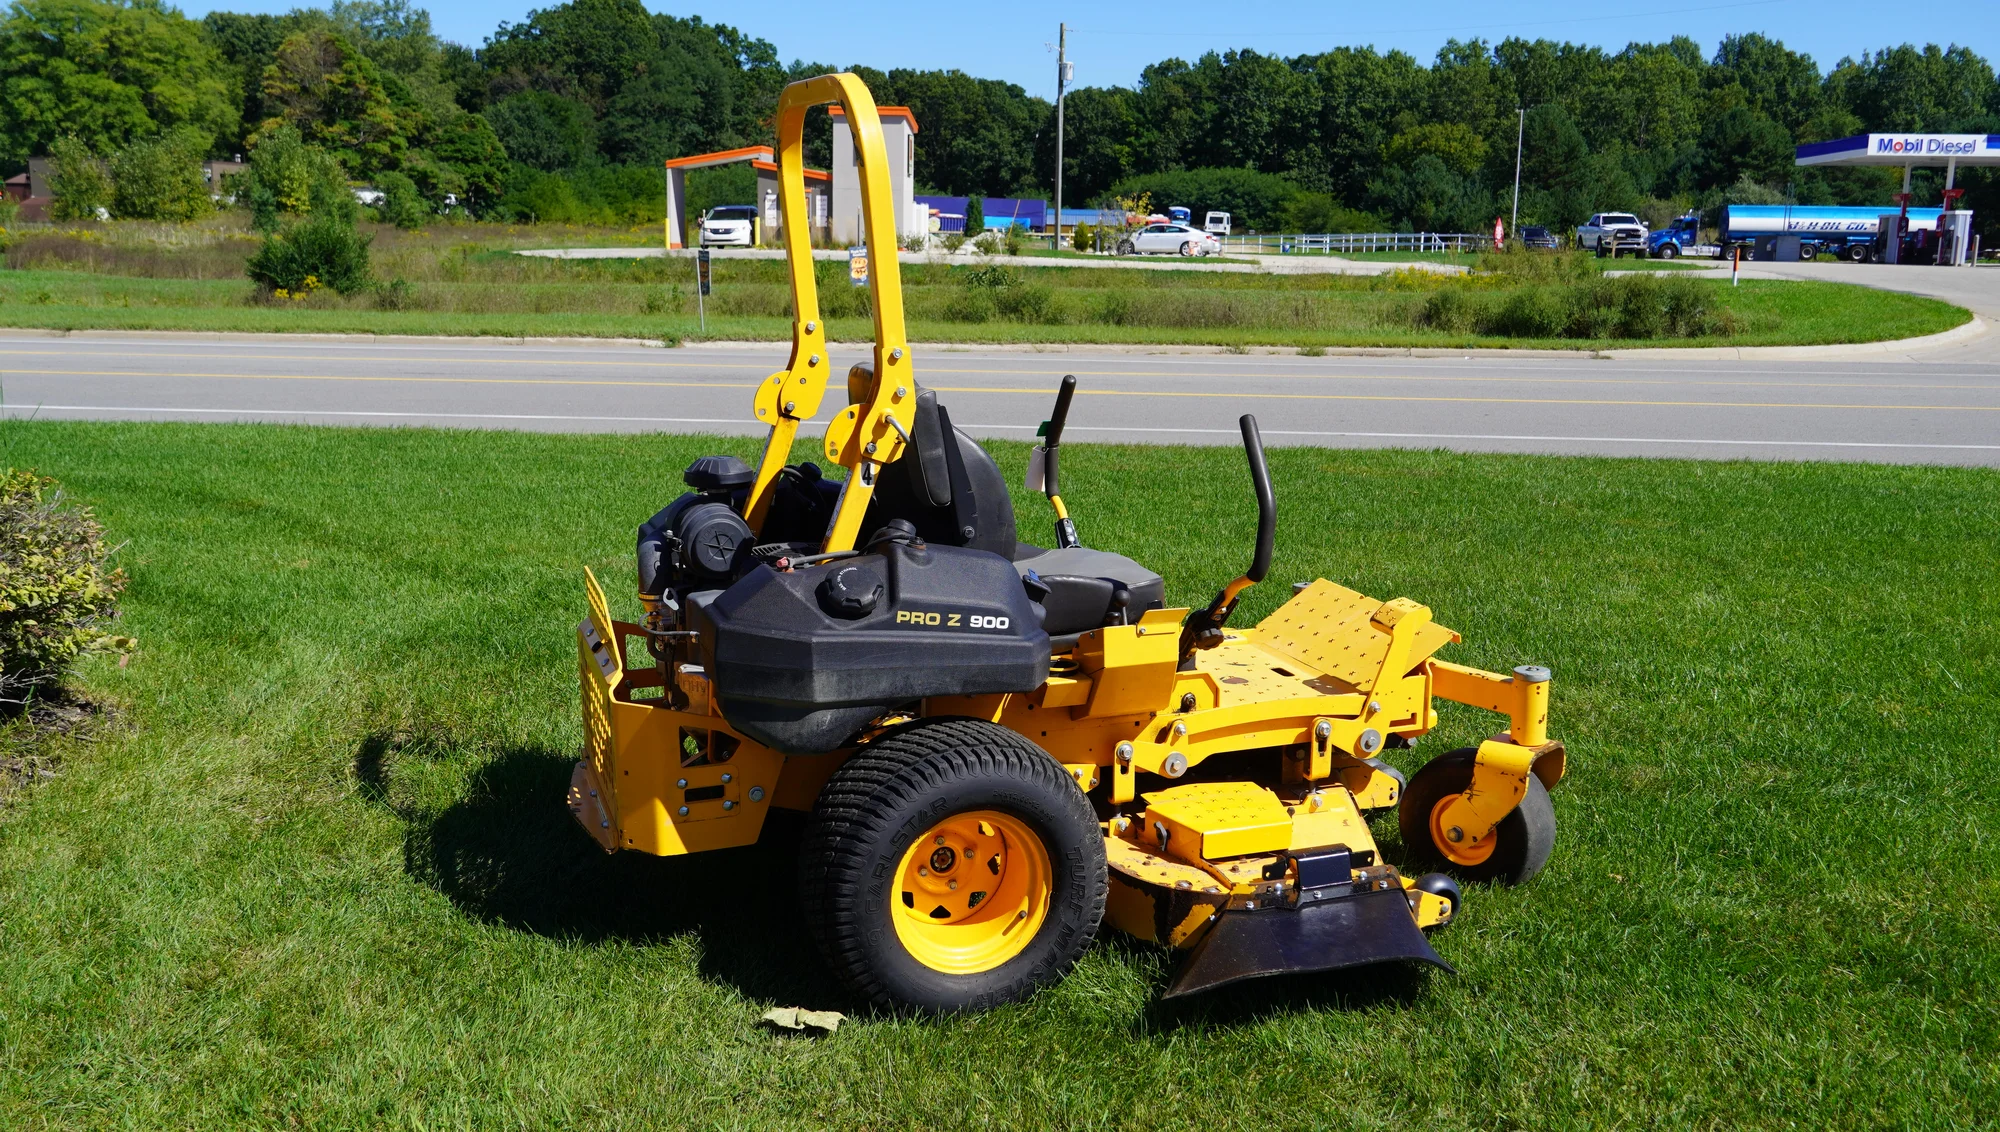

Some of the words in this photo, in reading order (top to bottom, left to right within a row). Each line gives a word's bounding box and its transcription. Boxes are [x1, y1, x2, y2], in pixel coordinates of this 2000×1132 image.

[1878, 138, 1924, 153] Mobil
[1927, 139, 1976, 153] Diesel
[1820, 222, 1841, 231] OIL
[862, 462, 872, 485] 4
[897, 610, 940, 626] PRO
[947, 613, 961, 627] Z
[969, 615, 1009, 630] 900
[864, 795, 948, 915] CARLSTAR
[1066, 845, 1086, 922] TURF
[977, 922, 1075, 1008] MASTER
